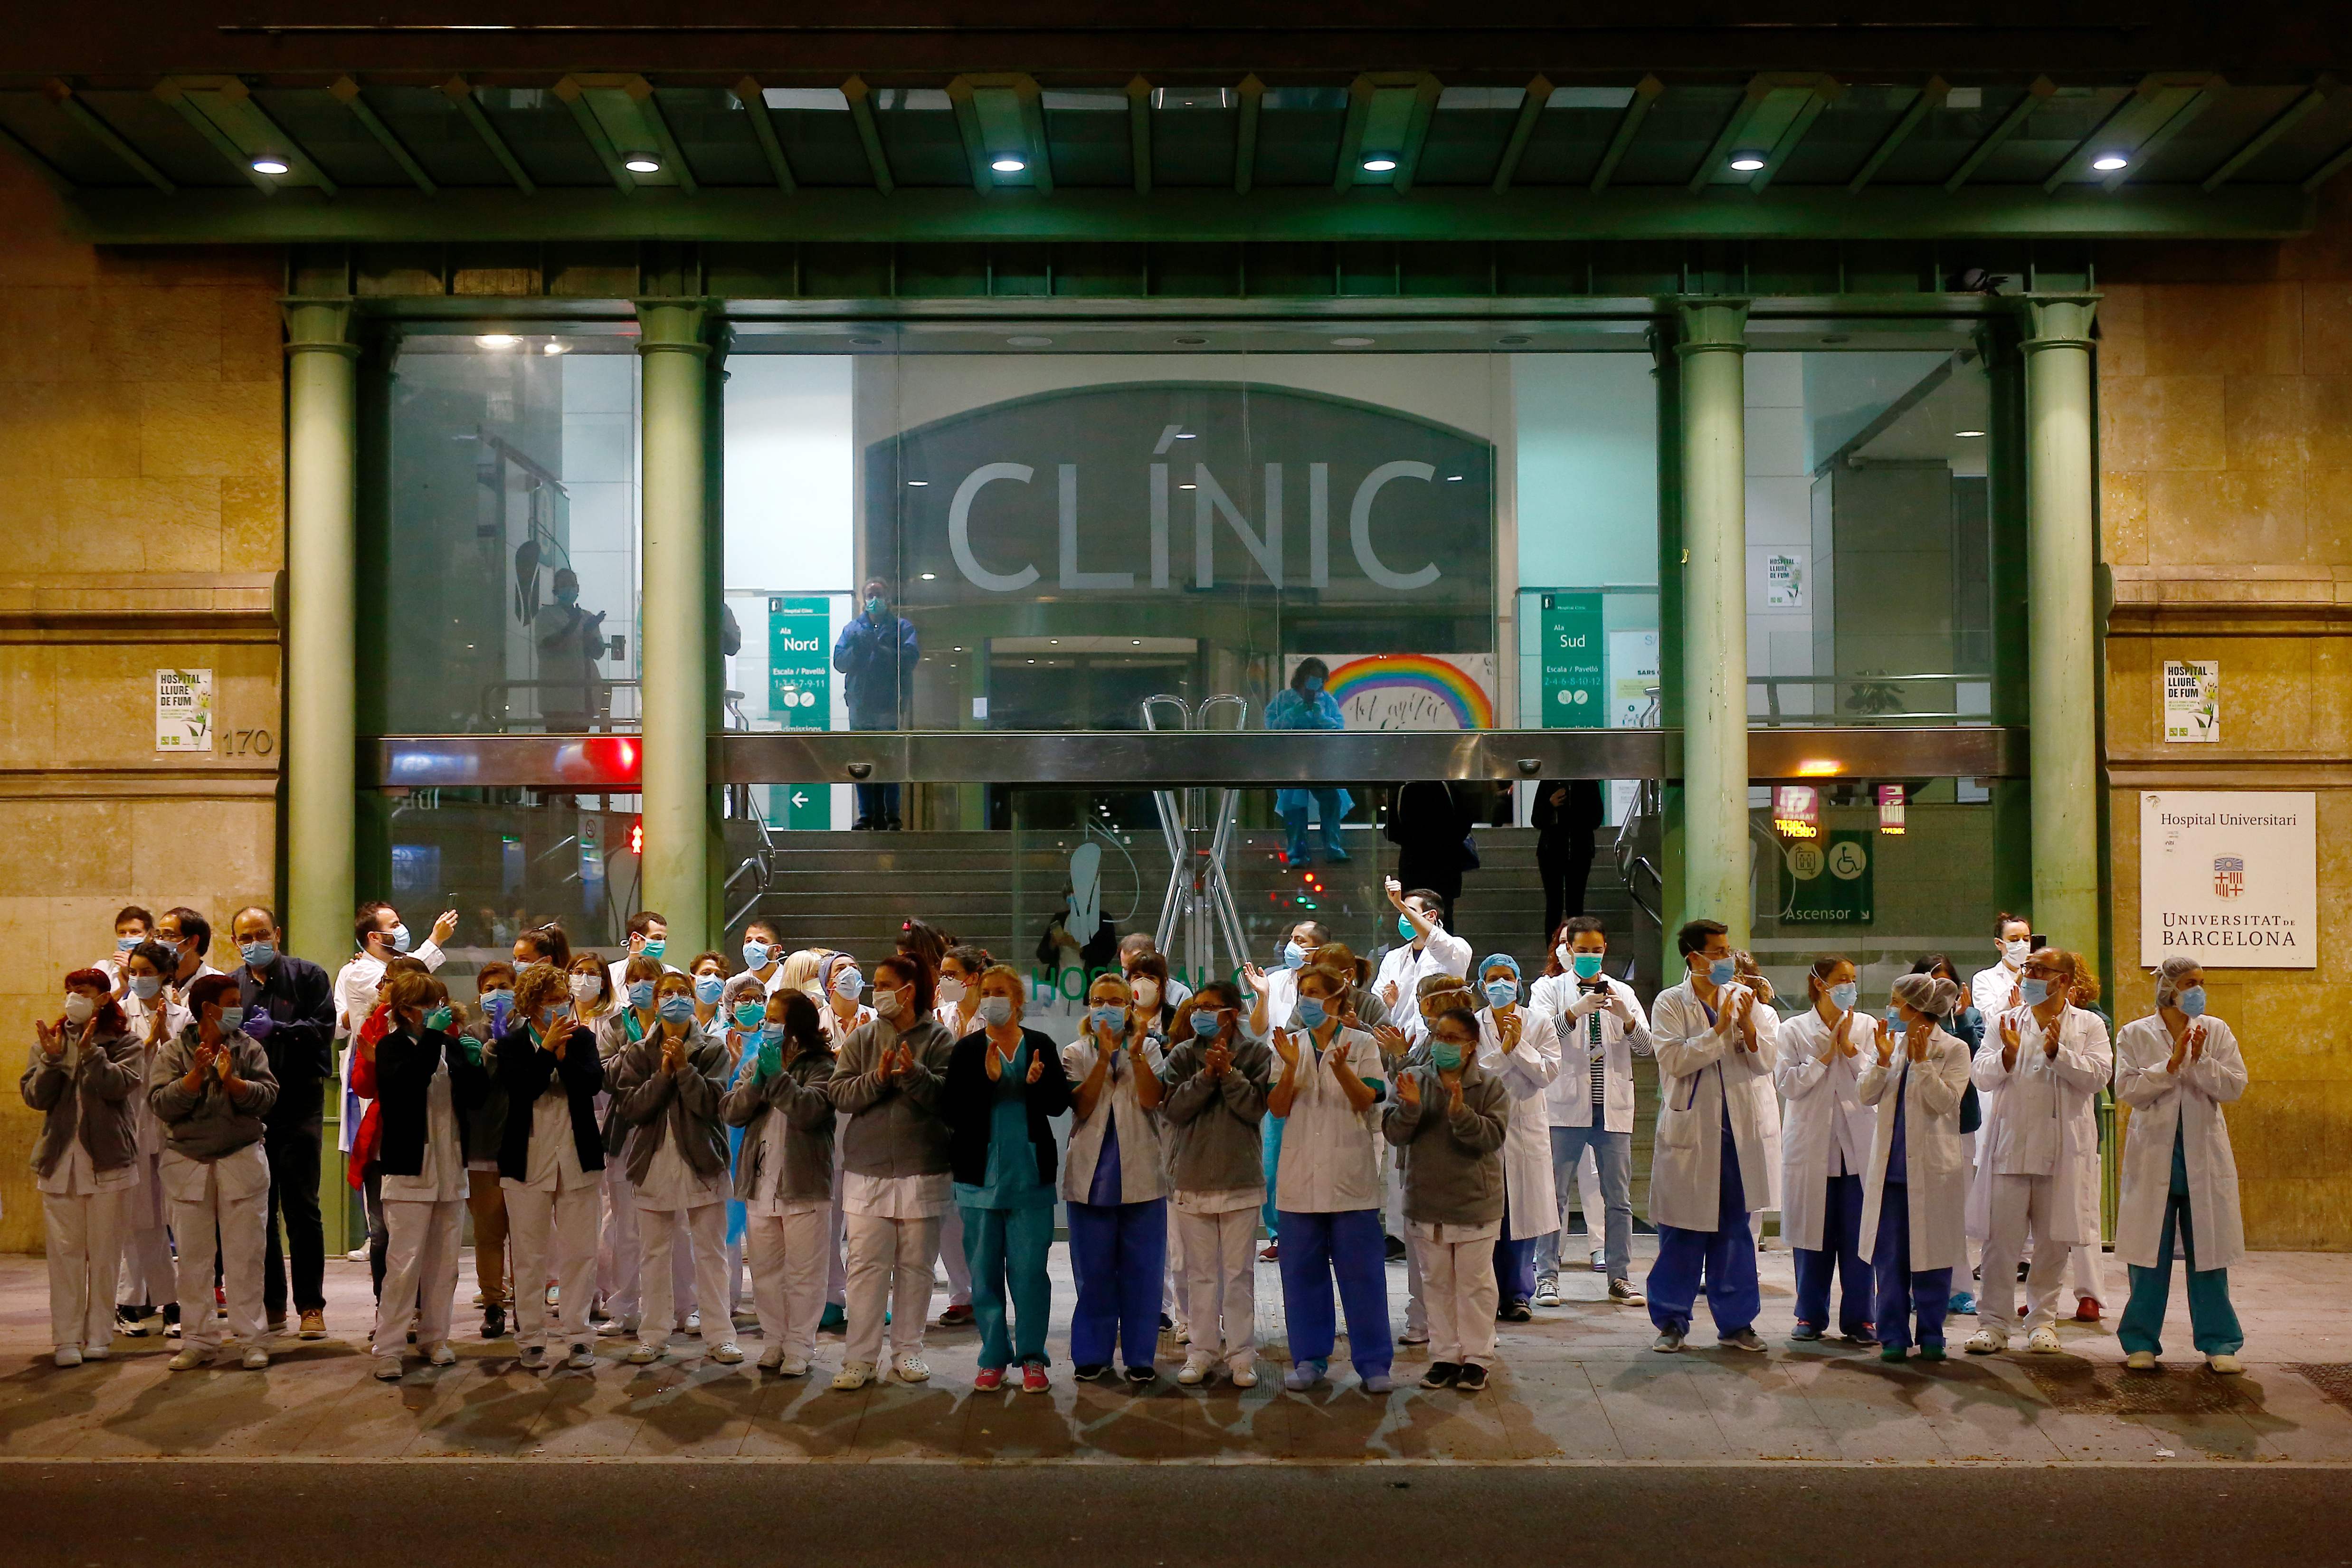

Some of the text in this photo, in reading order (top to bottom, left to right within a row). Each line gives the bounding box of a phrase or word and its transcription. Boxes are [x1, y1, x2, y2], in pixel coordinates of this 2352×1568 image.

[948, 424, 1442, 592] CLÍNIC
[784, 637, 818, 651] Nord
[1560, 634, 1585, 648] Sud
[2168, 666, 2207, 676] HOSPITAL
[161, 674, 201, 684] HOSPITAL
[2168, 677, 2196, 686] LLIURE
[161, 685, 190, 695] LLIURE
[2168, 689, 2199, 698] DE FUM
[161, 697, 191, 706] DE FUM
[223, 729, 273, 755] 170
[2161, 813, 2296, 828] Hospital Universitari
[1785, 908, 1851, 920] Ascensor
[2163, 913, 2281, 927] UNIVERSITAT
[2162, 931, 2296, 946] BARCELONA
